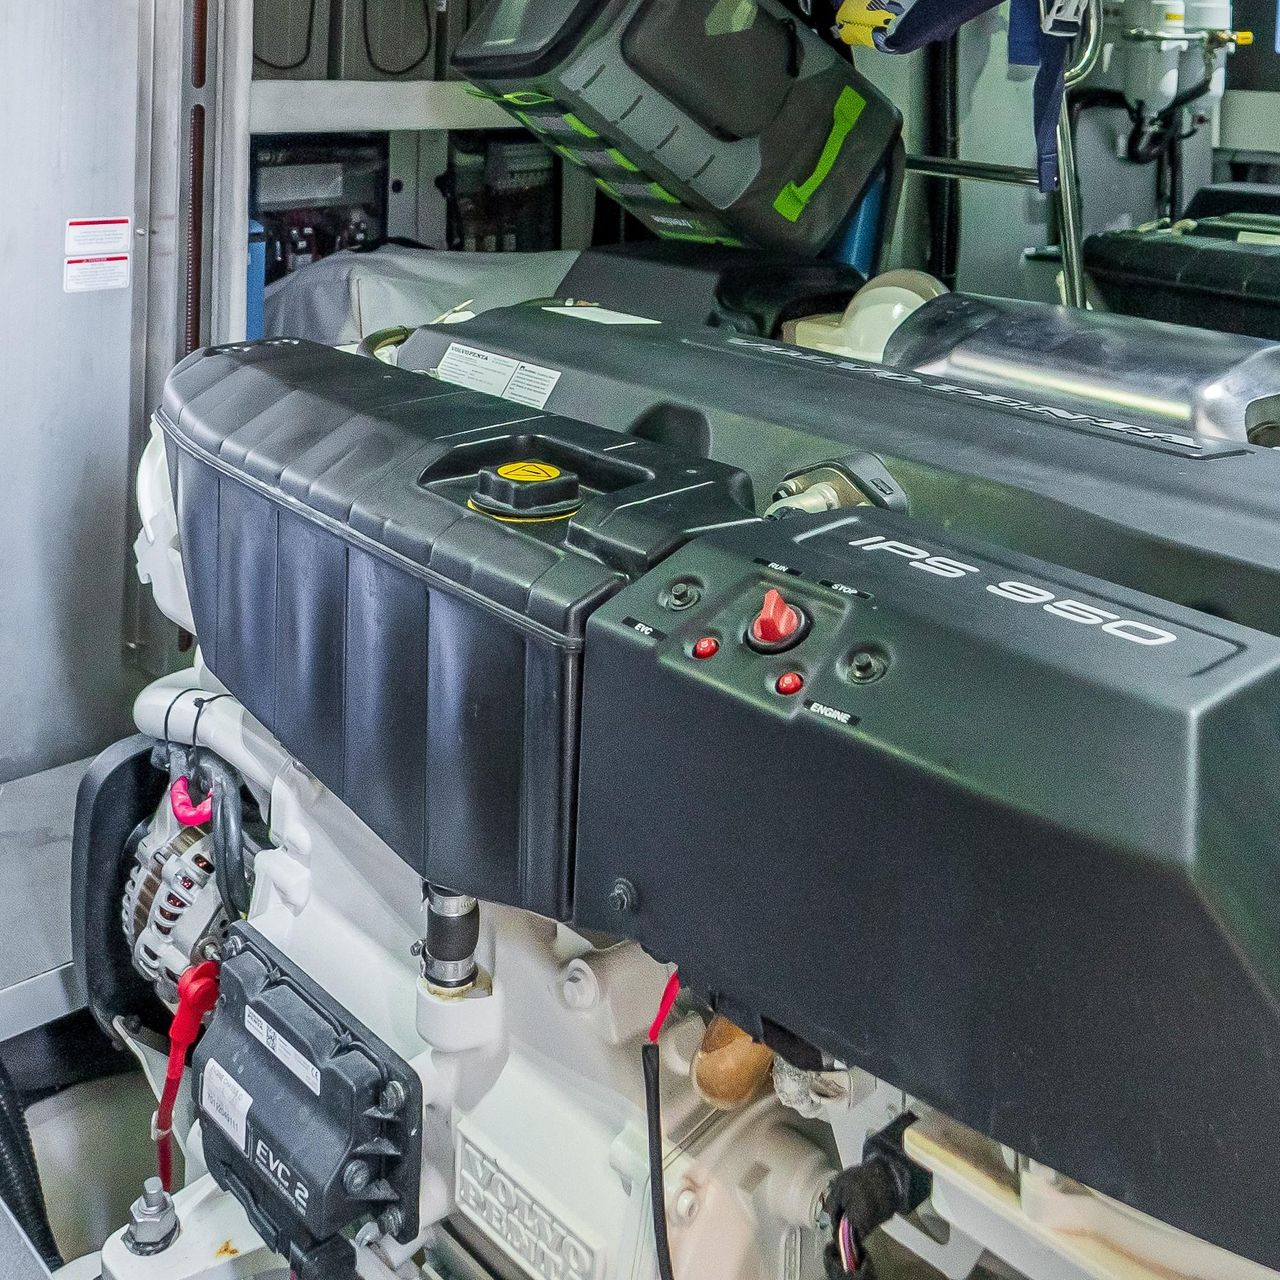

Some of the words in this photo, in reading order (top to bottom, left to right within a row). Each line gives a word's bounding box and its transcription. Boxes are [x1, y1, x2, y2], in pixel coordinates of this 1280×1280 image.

[728, 337, 922, 385] VOLVO
[922, 383, 1203, 449] PENTA
[768, 561, 789, 572] RUN
[831, 583, 858, 595] STOP
[849, 536, 980, 578] IPS
[986, 581, 1177, 645] 950
[634, 623, 653, 636] EVC
[810, 702, 851, 723] ENGINE
[256, 1139, 291, 1188] EVC
[294, 1181, 309, 1208] 2
[461, 1142, 592, 1276] VOLVO
